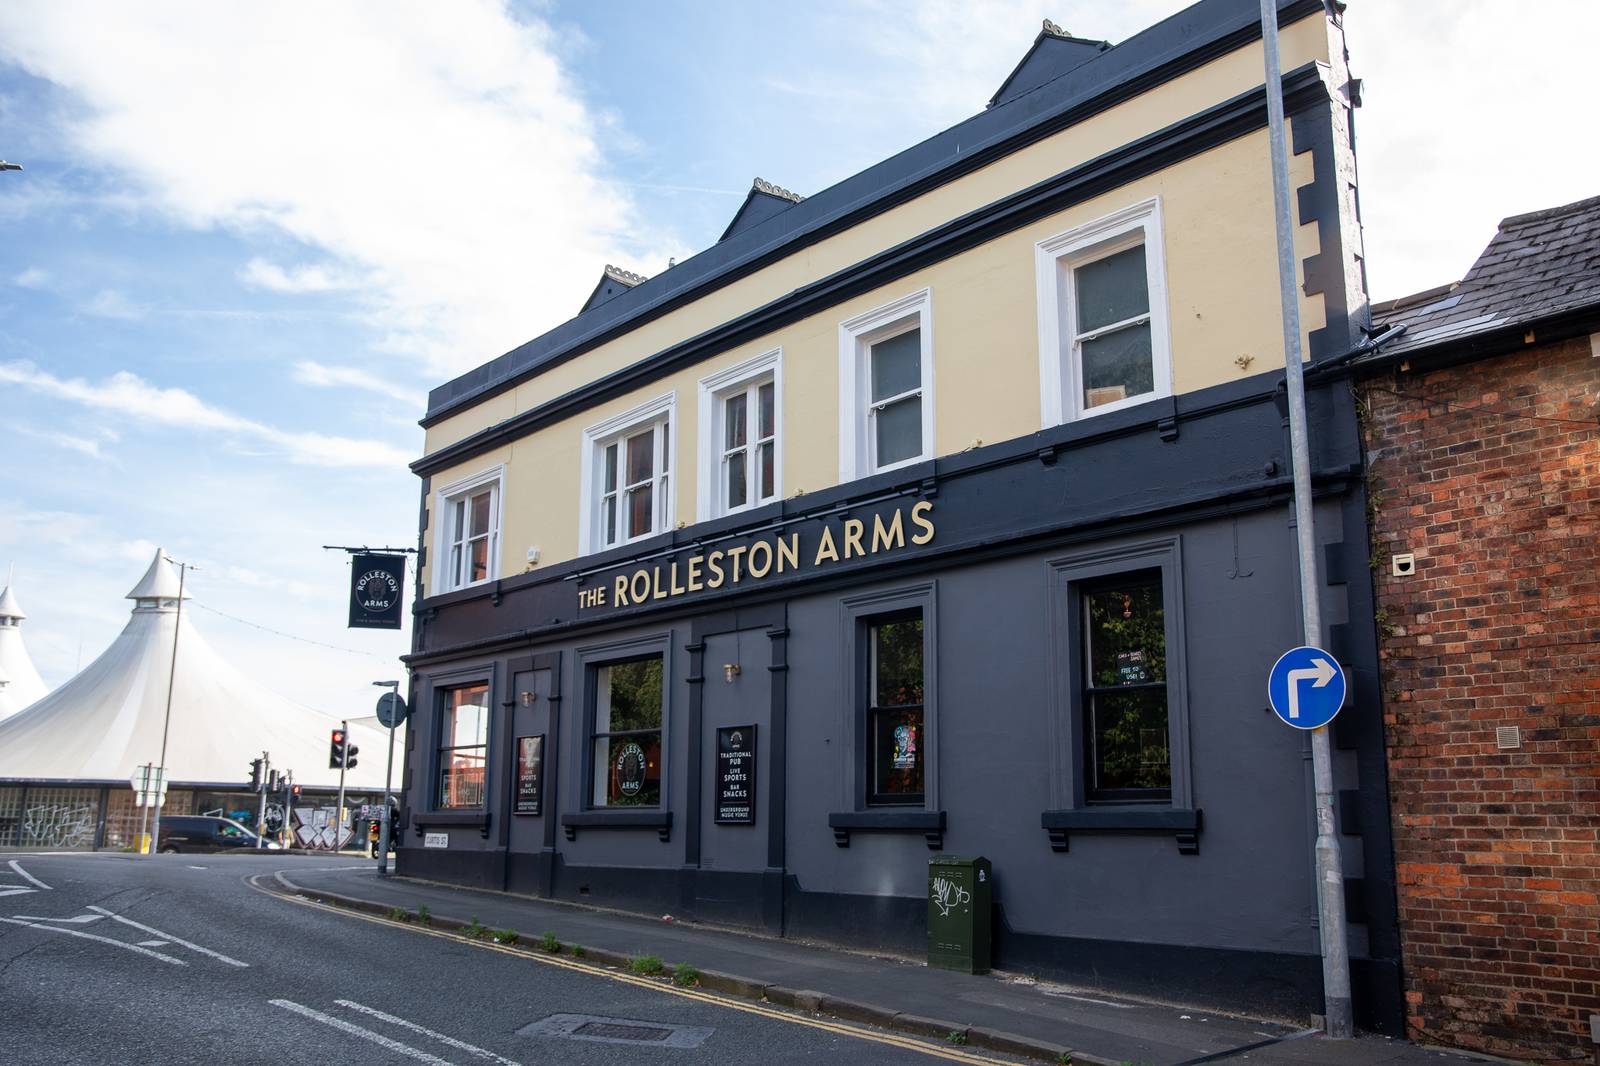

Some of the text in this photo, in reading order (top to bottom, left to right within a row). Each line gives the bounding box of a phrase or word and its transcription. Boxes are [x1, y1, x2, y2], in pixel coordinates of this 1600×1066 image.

[578, 501, 935, 609] THE ROLLESTON ARMS
[357, 571, 398, 592] ROLLESTON
[617, 744, 646, 770] ROLLESTON
[622, 781, 640, 789] ARMS
